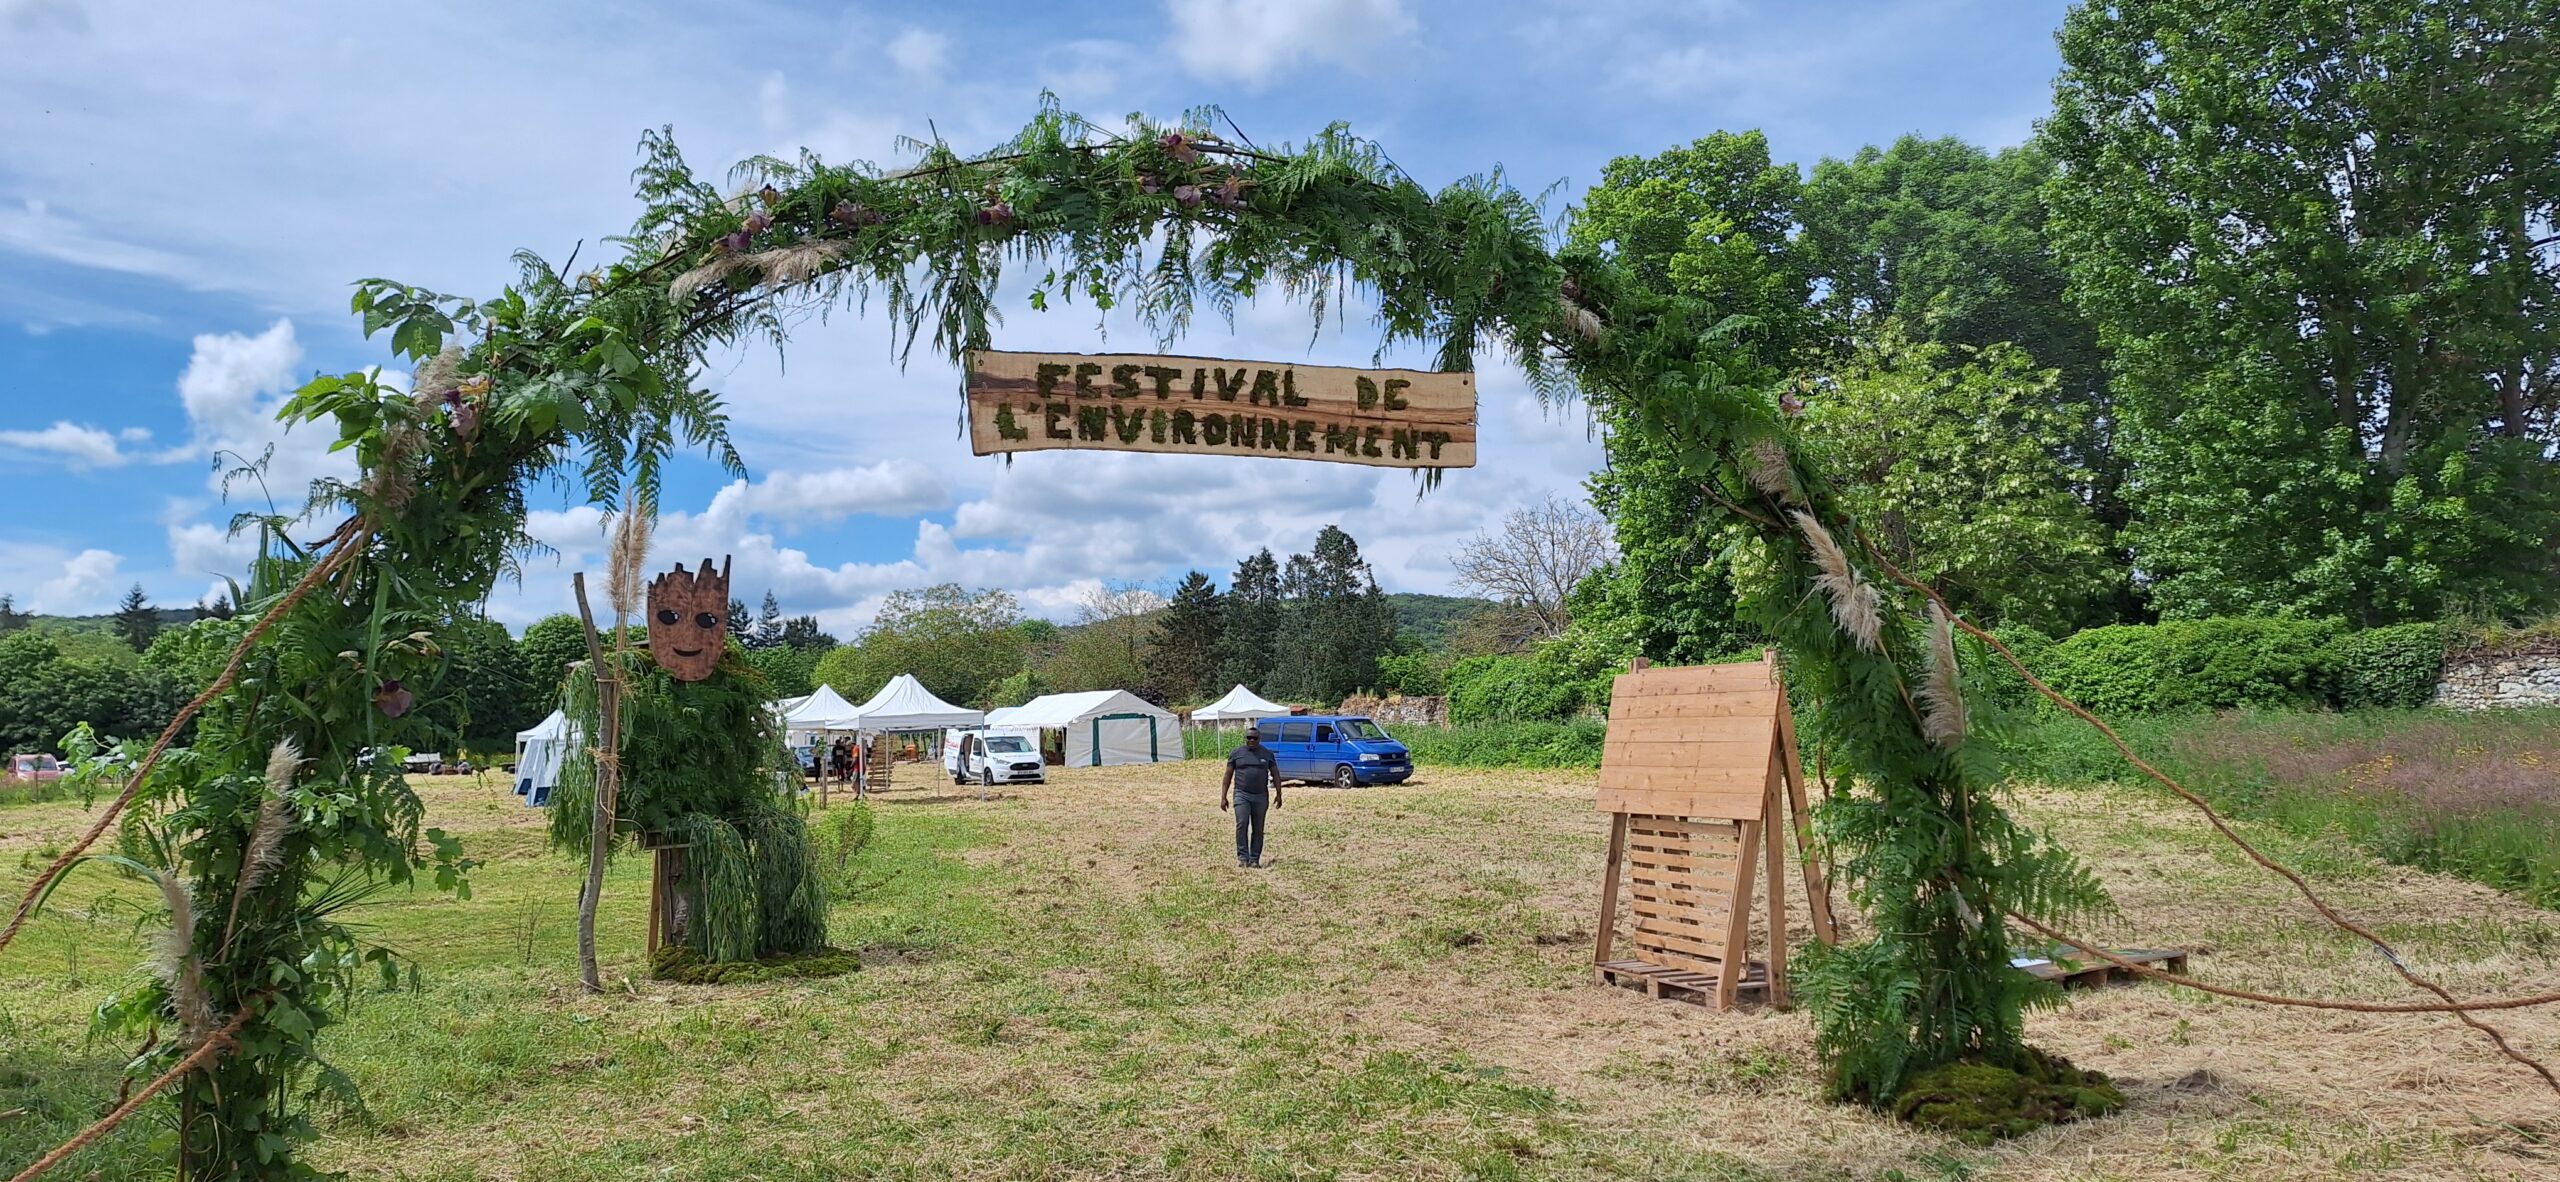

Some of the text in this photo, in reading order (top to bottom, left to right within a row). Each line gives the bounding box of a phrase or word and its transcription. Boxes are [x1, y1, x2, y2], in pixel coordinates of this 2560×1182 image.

[1037, 362, 1411, 411] FESTIVAL DE
[995, 400, 1451, 460] L'ENVIRONNEMENT
